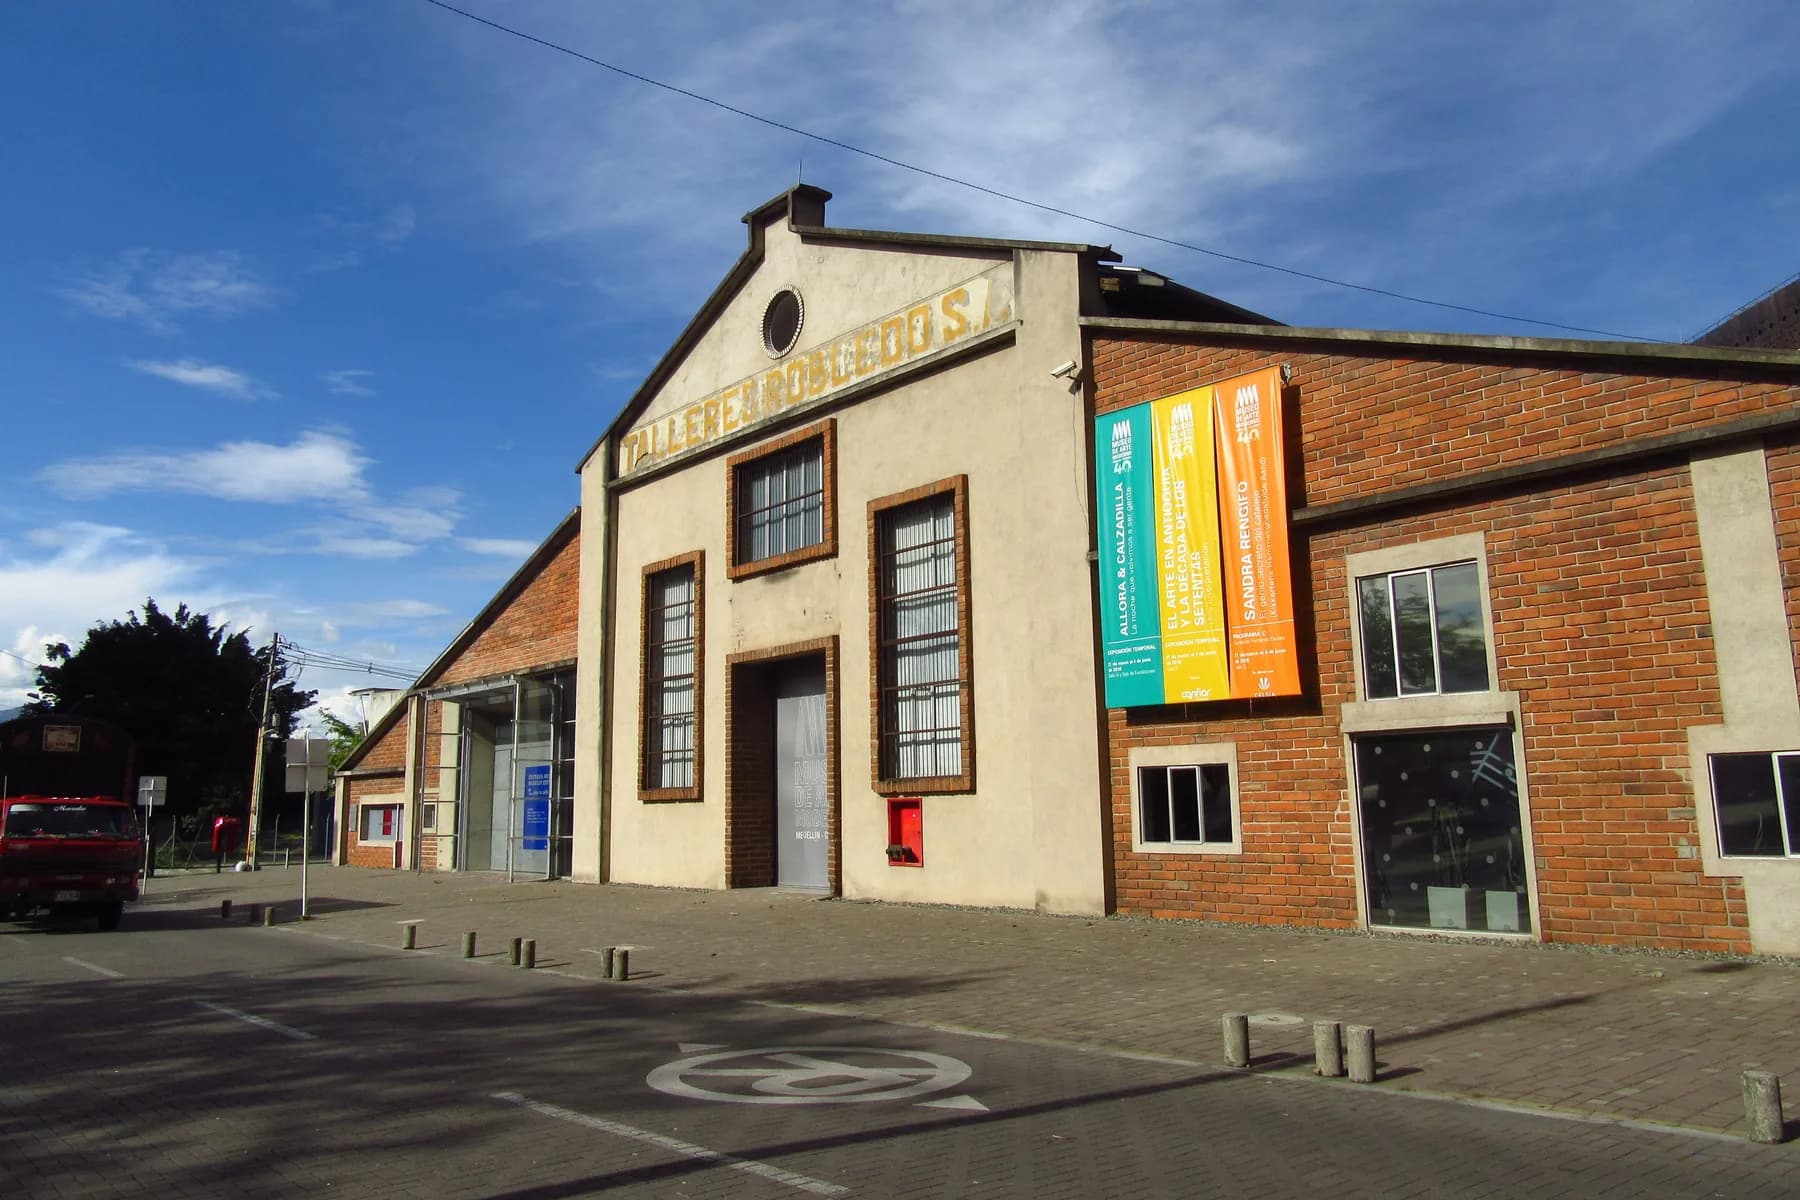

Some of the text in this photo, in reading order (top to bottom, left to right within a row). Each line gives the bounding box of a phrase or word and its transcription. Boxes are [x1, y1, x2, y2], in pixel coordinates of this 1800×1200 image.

[622, 380, 756, 472] TALLERES
[764, 304, 931, 413] ROBLEDO
[1114, 481, 1129, 636] ALLORA & CALZADILLA
[1127, 536, 1135, 576] volvimos
[1161, 468, 1178, 630] EL ARTE EN ANTIOQUIA
[1174, 480, 1191, 628] Y LA DÉCADA DE LOS
[1237, 481, 1256, 621] SANDRA RENGIFO
[1256, 544, 1265, 579] secreto
[1129, 597, 1137, 622] noche
[1190, 551, 1205, 626] SETENTAS
[1258, 581, 1267, 607] genio
[1130, 624, 1137, 635] La
